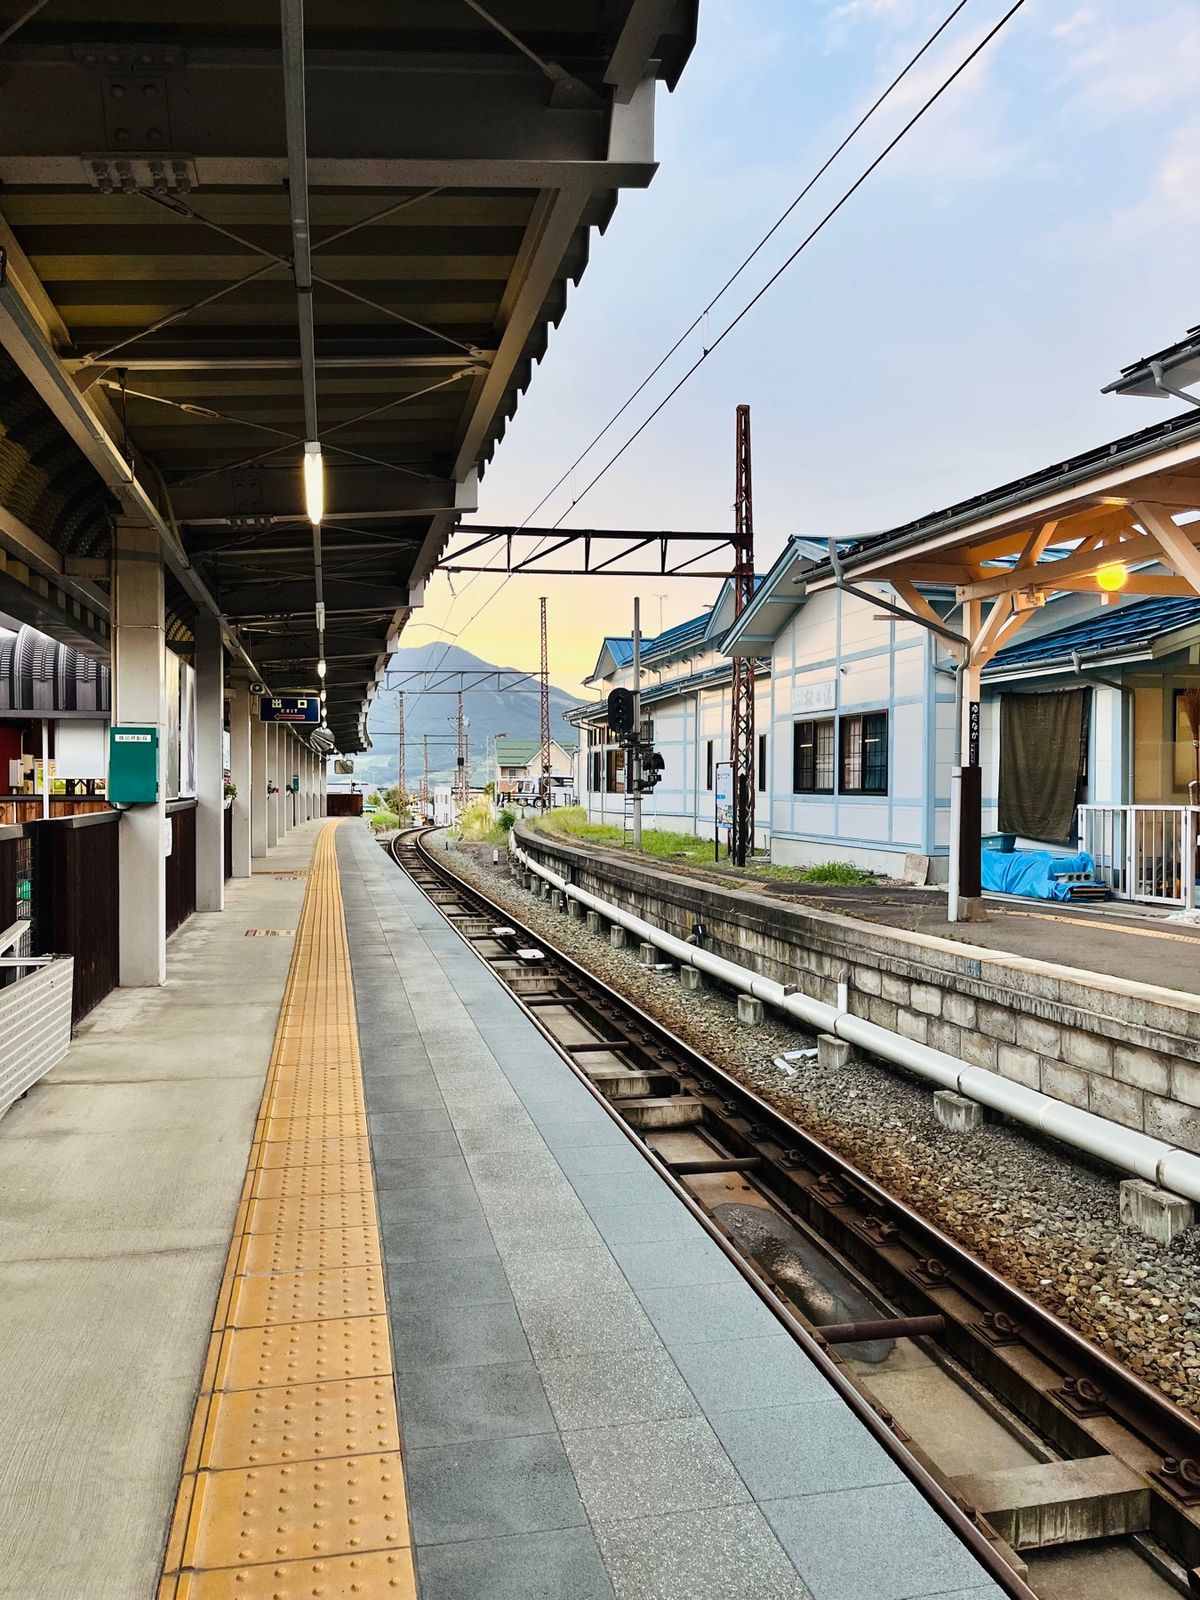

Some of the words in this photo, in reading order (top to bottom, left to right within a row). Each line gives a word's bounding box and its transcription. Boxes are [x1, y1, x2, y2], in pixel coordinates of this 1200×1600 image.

[272, 699, 307, 708] 出口
[971, 704, 979, 740] ゆだなか
